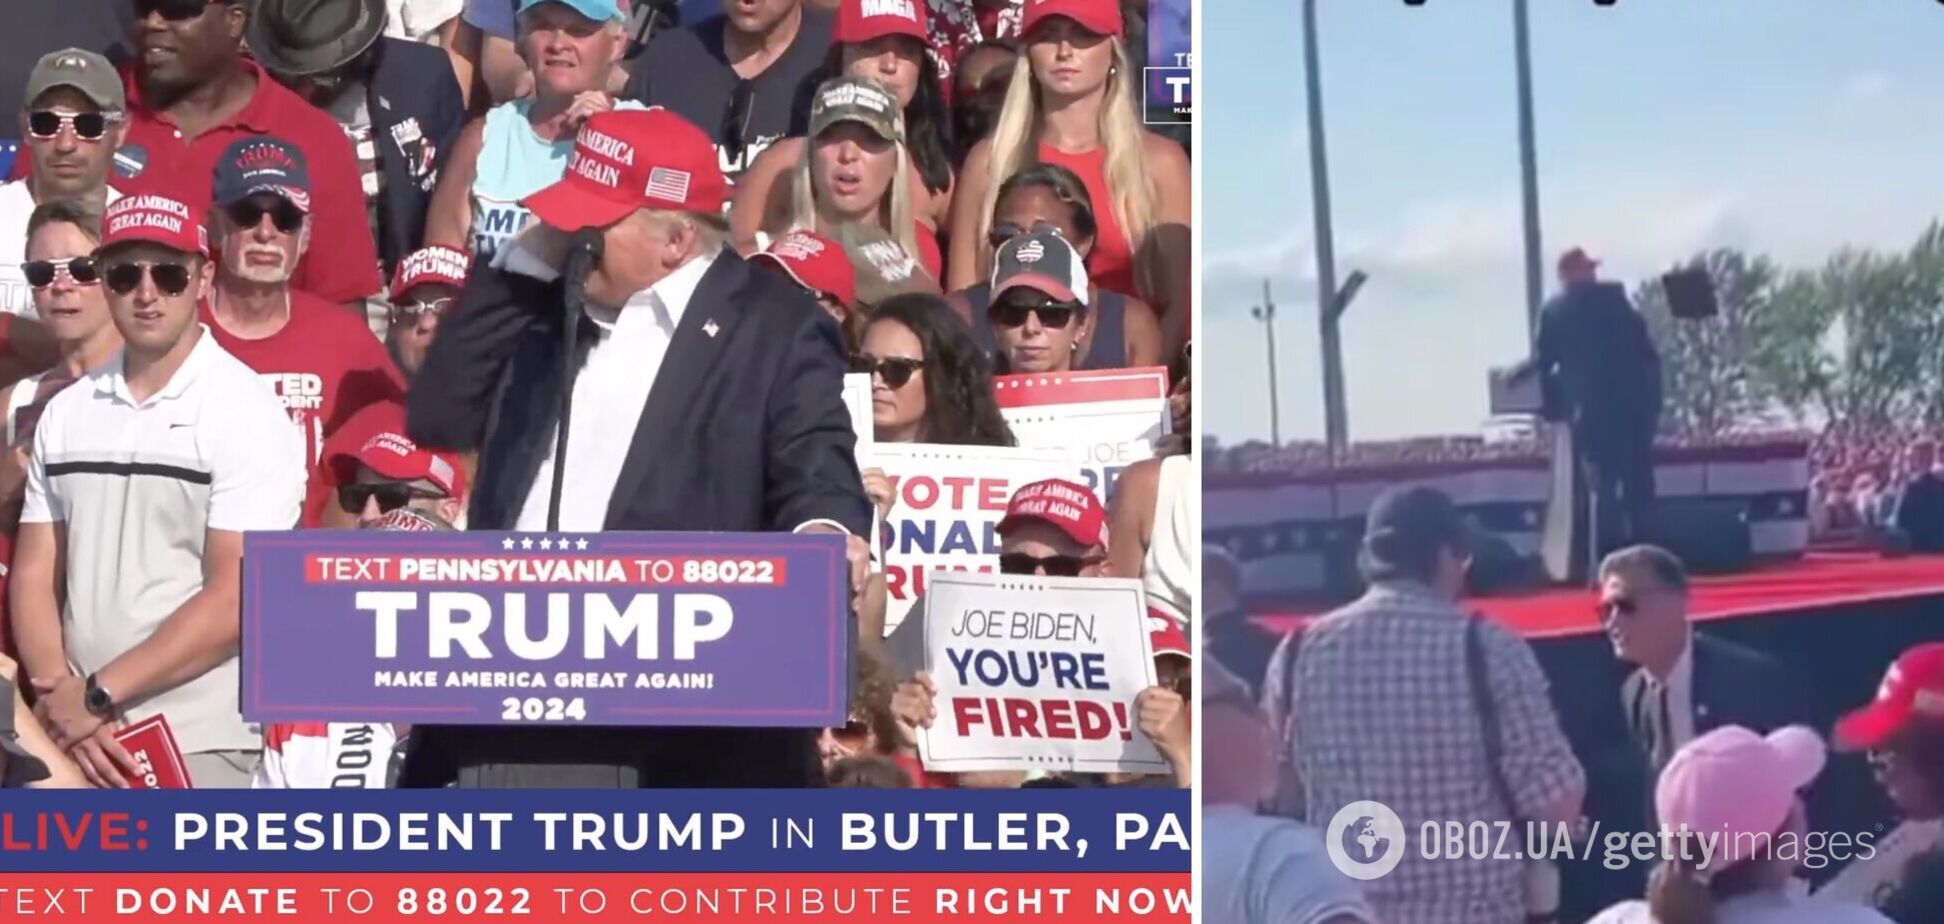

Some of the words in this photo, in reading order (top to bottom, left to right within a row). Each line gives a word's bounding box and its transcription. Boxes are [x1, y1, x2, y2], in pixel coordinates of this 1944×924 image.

[576, 156, 621, 188] AGAIN
[136, 195, 189, 219] AMERICA
[144, 213, 182, 234] AGAIN
[402, 246, 469, 270] WOMEN
[317, 557, 391, 580] TEXT
[399, 558, 627, 582] PENNSYLVANIA
[635, 559, 674, 583] TO
[682, 559, 774, 583] 88022
[355, 591, 734, 660] TRUMP
[951, 609, 1006, 637] JOE
[1010, 612, 1097, 643] BIDEN,
[374, 671, 438, 687] MAKE
[445, 671, 547, 688] AMERICA
[554, 672, 628, 688] GREAT
[635, 672, 714, 689] AGAIN!
[502, 697, 586, 721] 2024
[952, 697, 1132, 742] FIRED!
